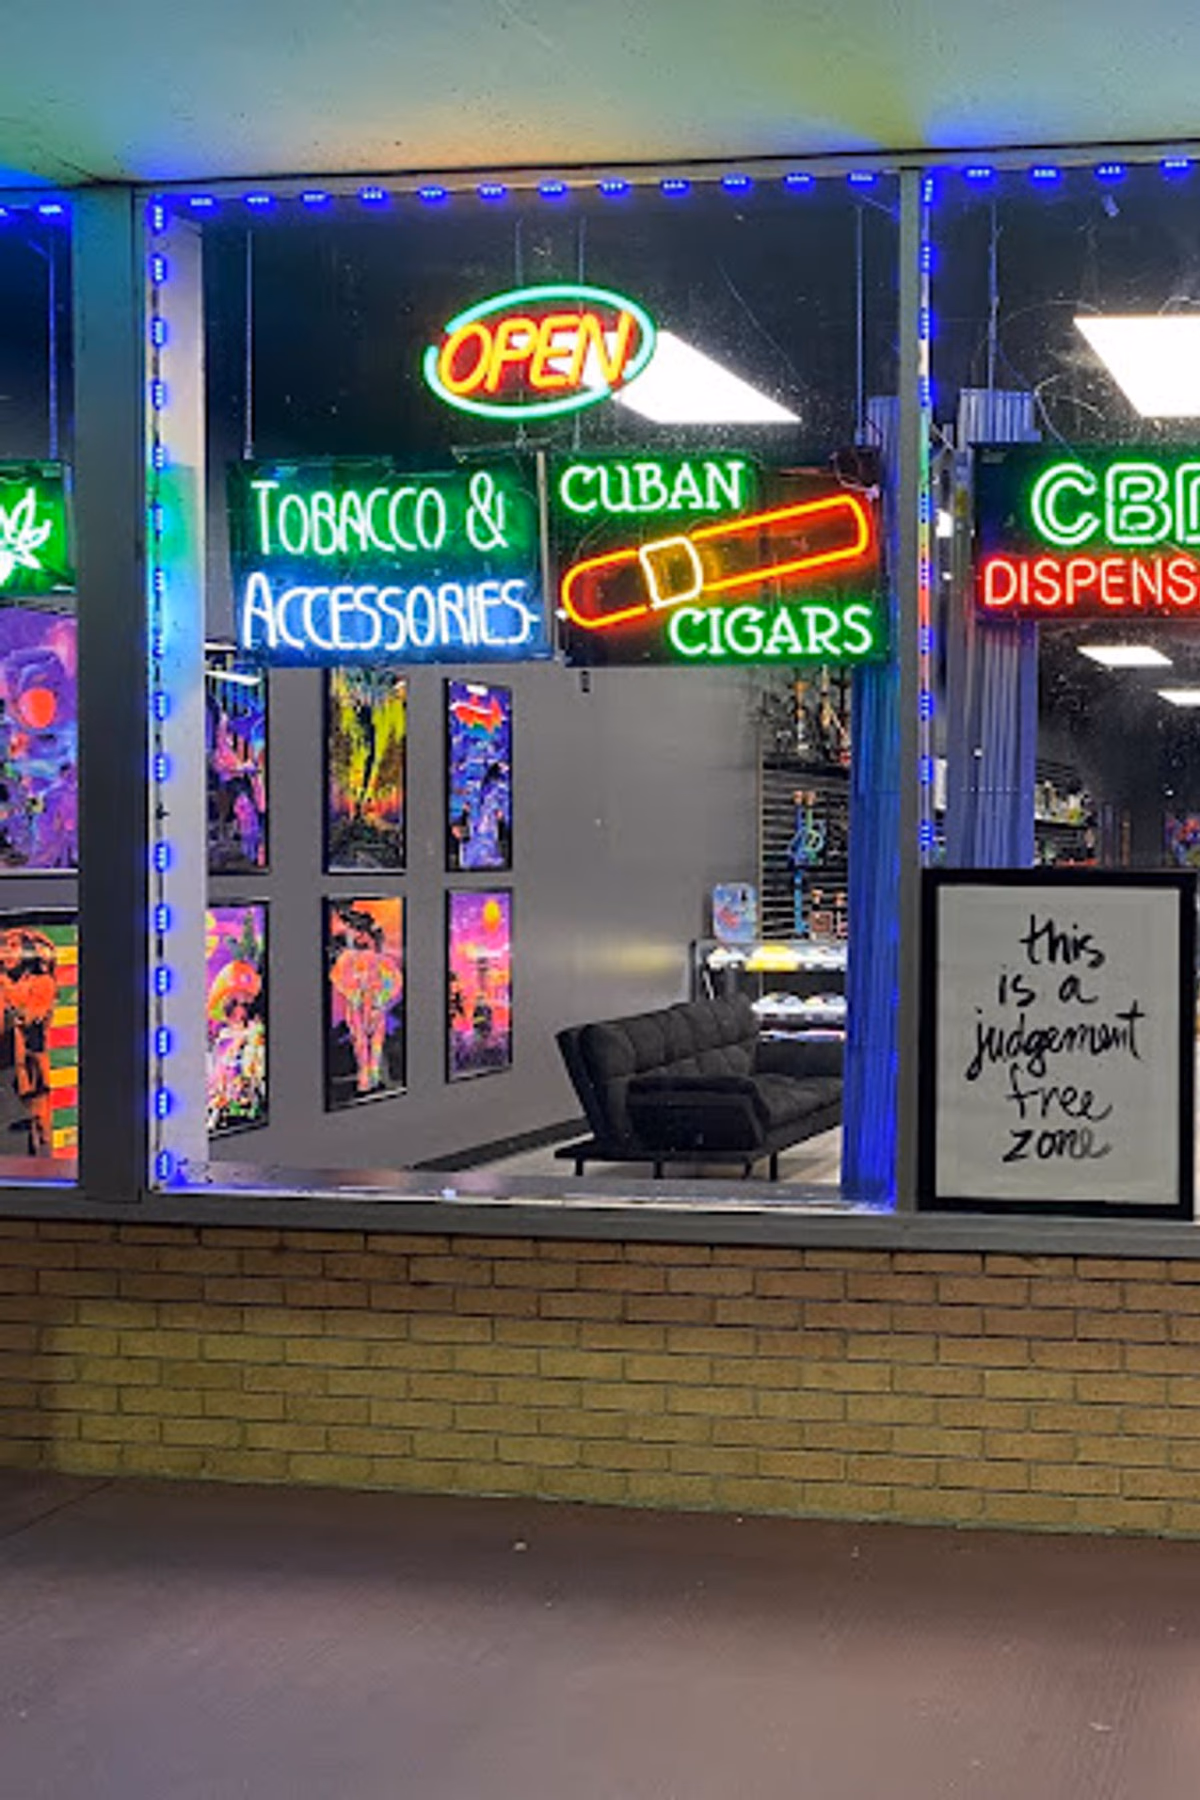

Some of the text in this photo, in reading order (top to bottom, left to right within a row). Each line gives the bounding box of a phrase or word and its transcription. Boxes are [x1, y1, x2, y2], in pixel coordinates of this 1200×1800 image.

[438, 311, 637, 395] OPEN
[250, 470, 509, 556] TOBACCO &
[559, 461, 747, 512] CUBAN
[242, 571, 533, 650] ACCESSORIES
[668, 605, 874, 657] CIGARS
[1019, 913, 1106, 969] this
[997, 965, 1099, 1007] is a
[964, 1000, 1146, 1082] judgement
[1005, 1063, 1113, 1122] free
[1002, 1129, 1112, 1163] zone
